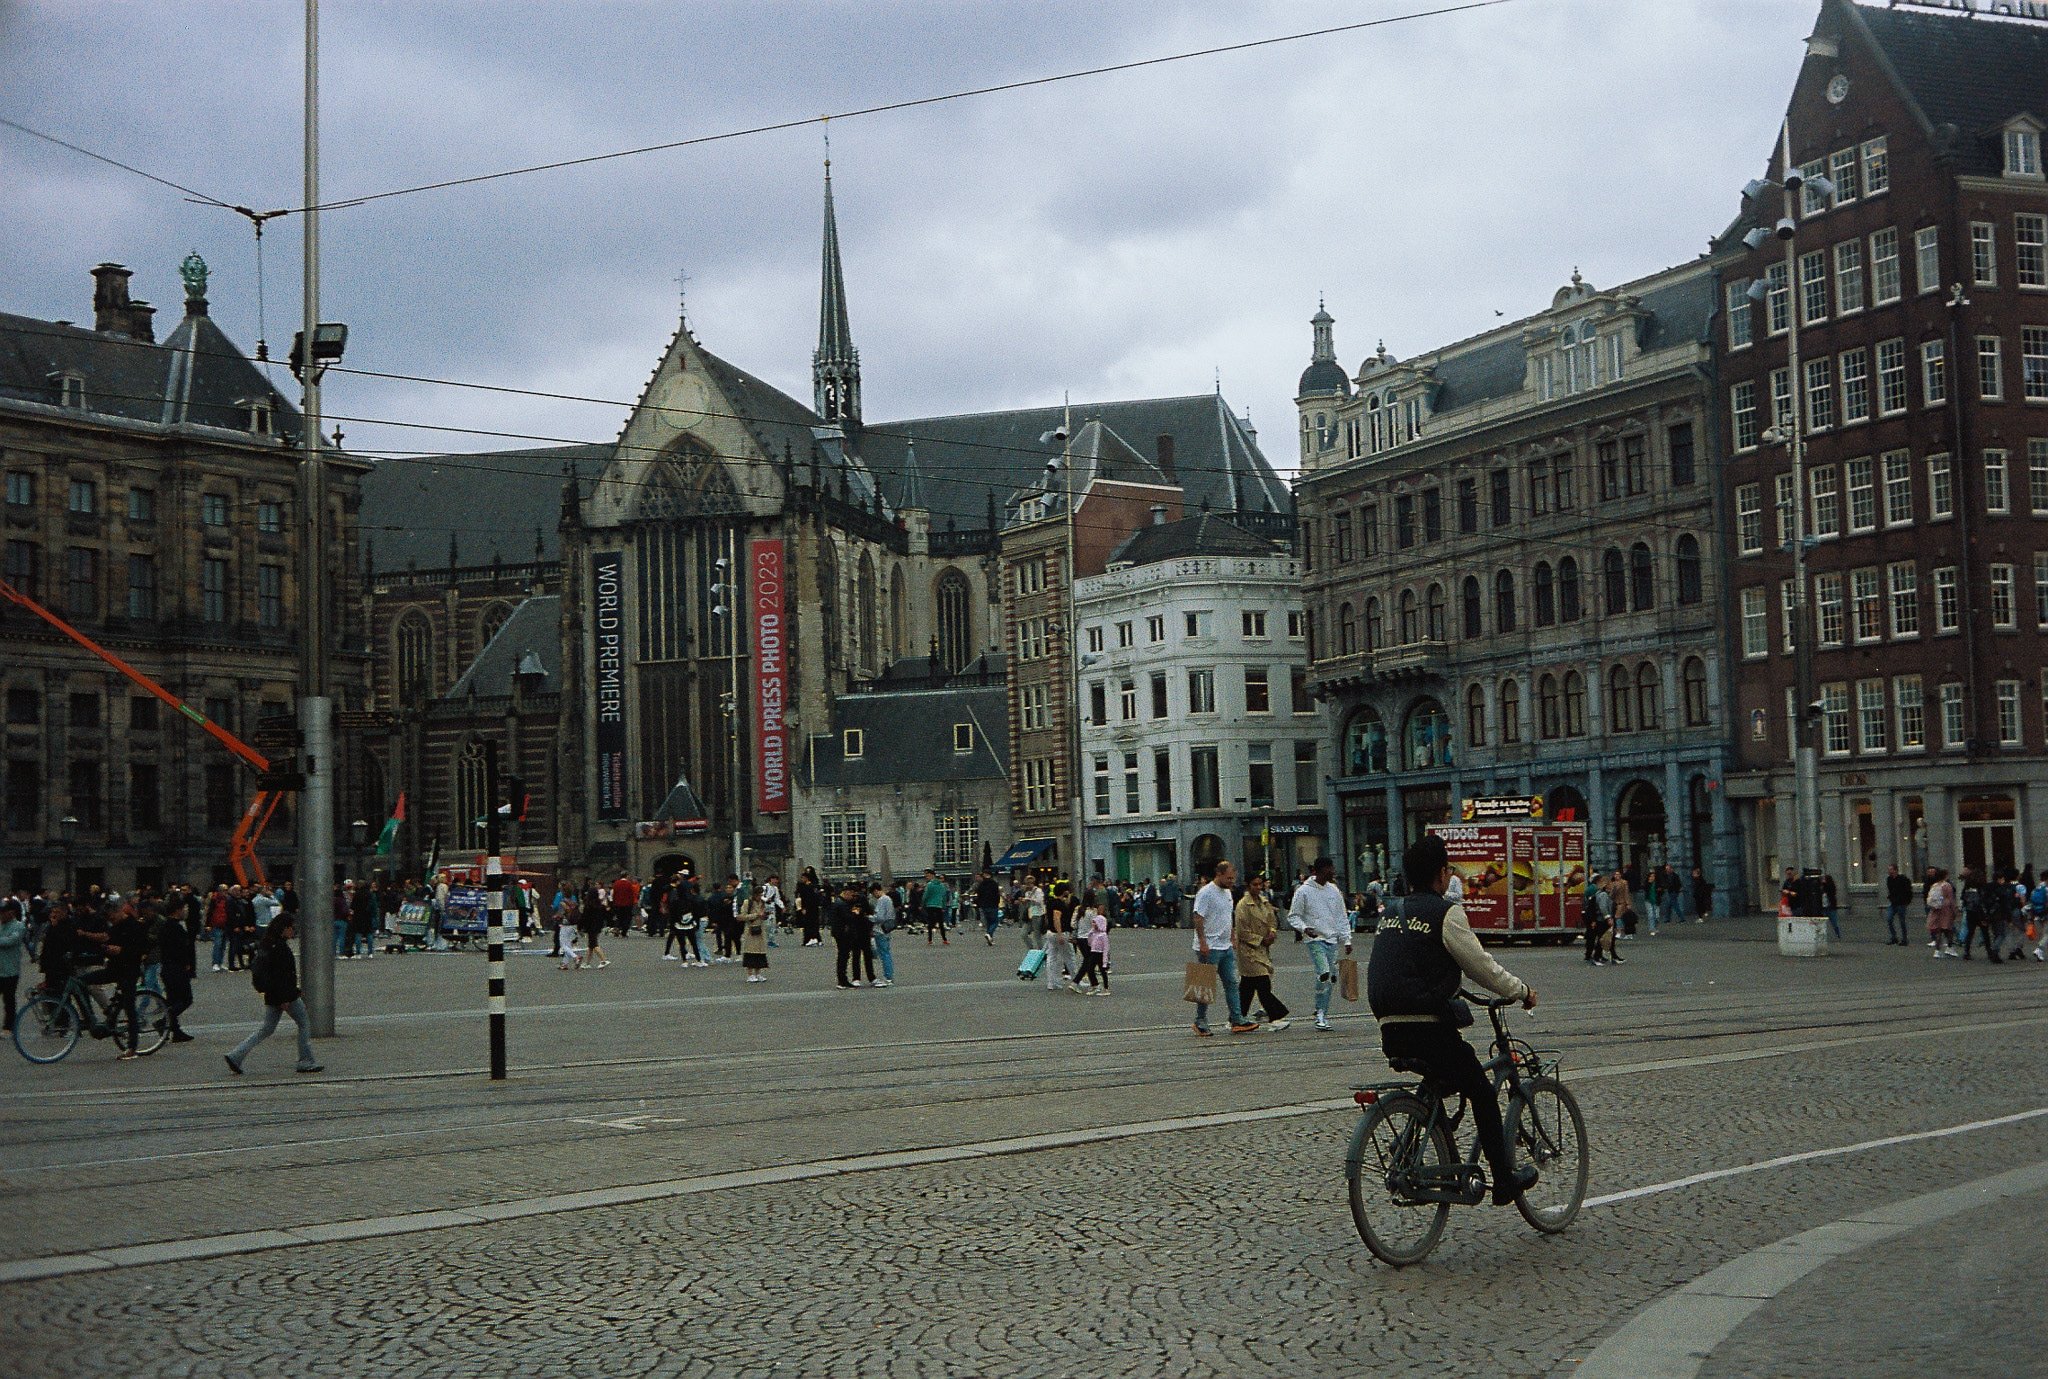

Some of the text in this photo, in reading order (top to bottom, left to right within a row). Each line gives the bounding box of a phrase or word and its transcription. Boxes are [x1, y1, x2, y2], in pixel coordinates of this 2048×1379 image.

[598, 563, 621, 723] WORLD PREMIERE
[758, 551, 784, 800] WORLD PRESS PHOTO 2023
